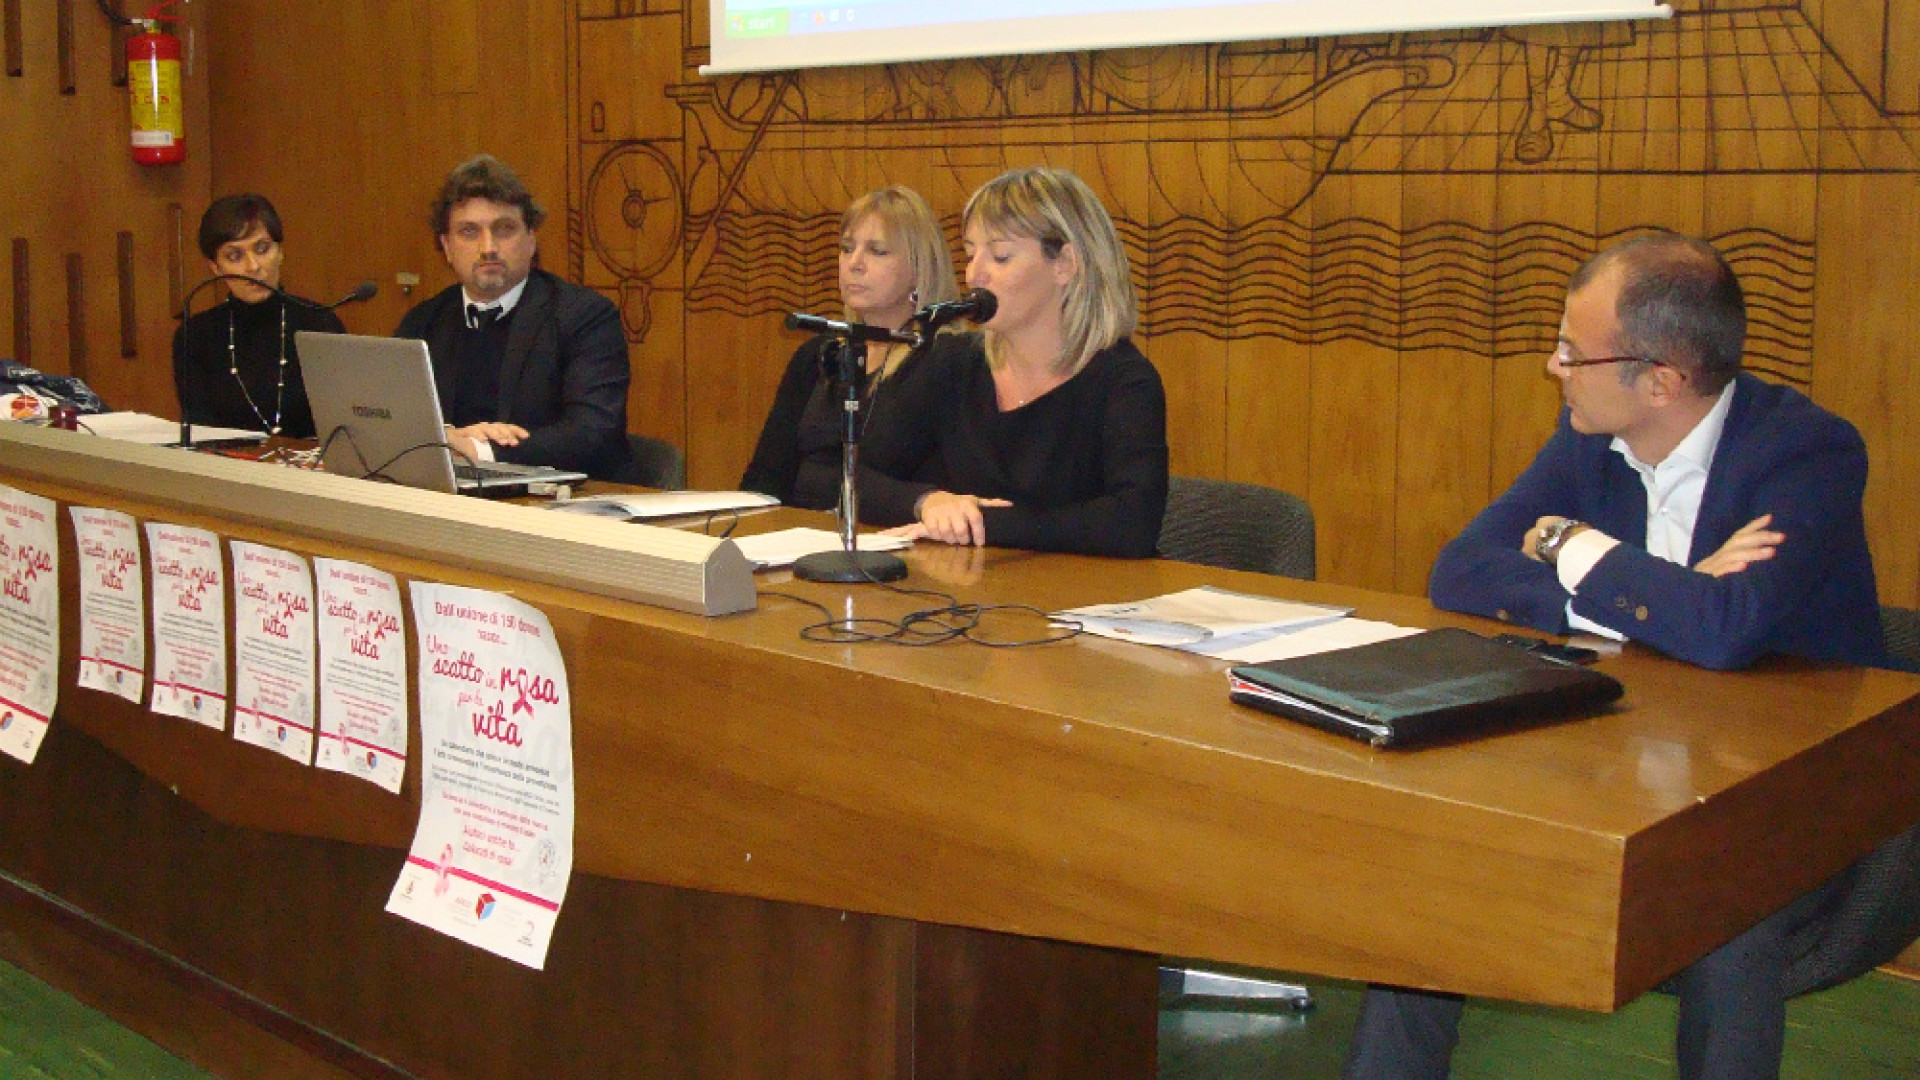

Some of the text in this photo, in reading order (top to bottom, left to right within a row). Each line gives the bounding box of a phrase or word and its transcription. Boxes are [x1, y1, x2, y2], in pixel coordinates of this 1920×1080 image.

[351, 406, 392, 420] TOSHIBA
[4, 568, 31, 605] vita
[262, 610, 288, 639] vita
[489, 611, 499, 626] di
[501, 614, 516, 630] 150
[351, 630, 379, 660] vita
[426, 632, 449, 655] Uno
[433, 651, 484, 684] scatto
[501, 667, 560, 713] rosa
[472, 700, 523, 748] vita
